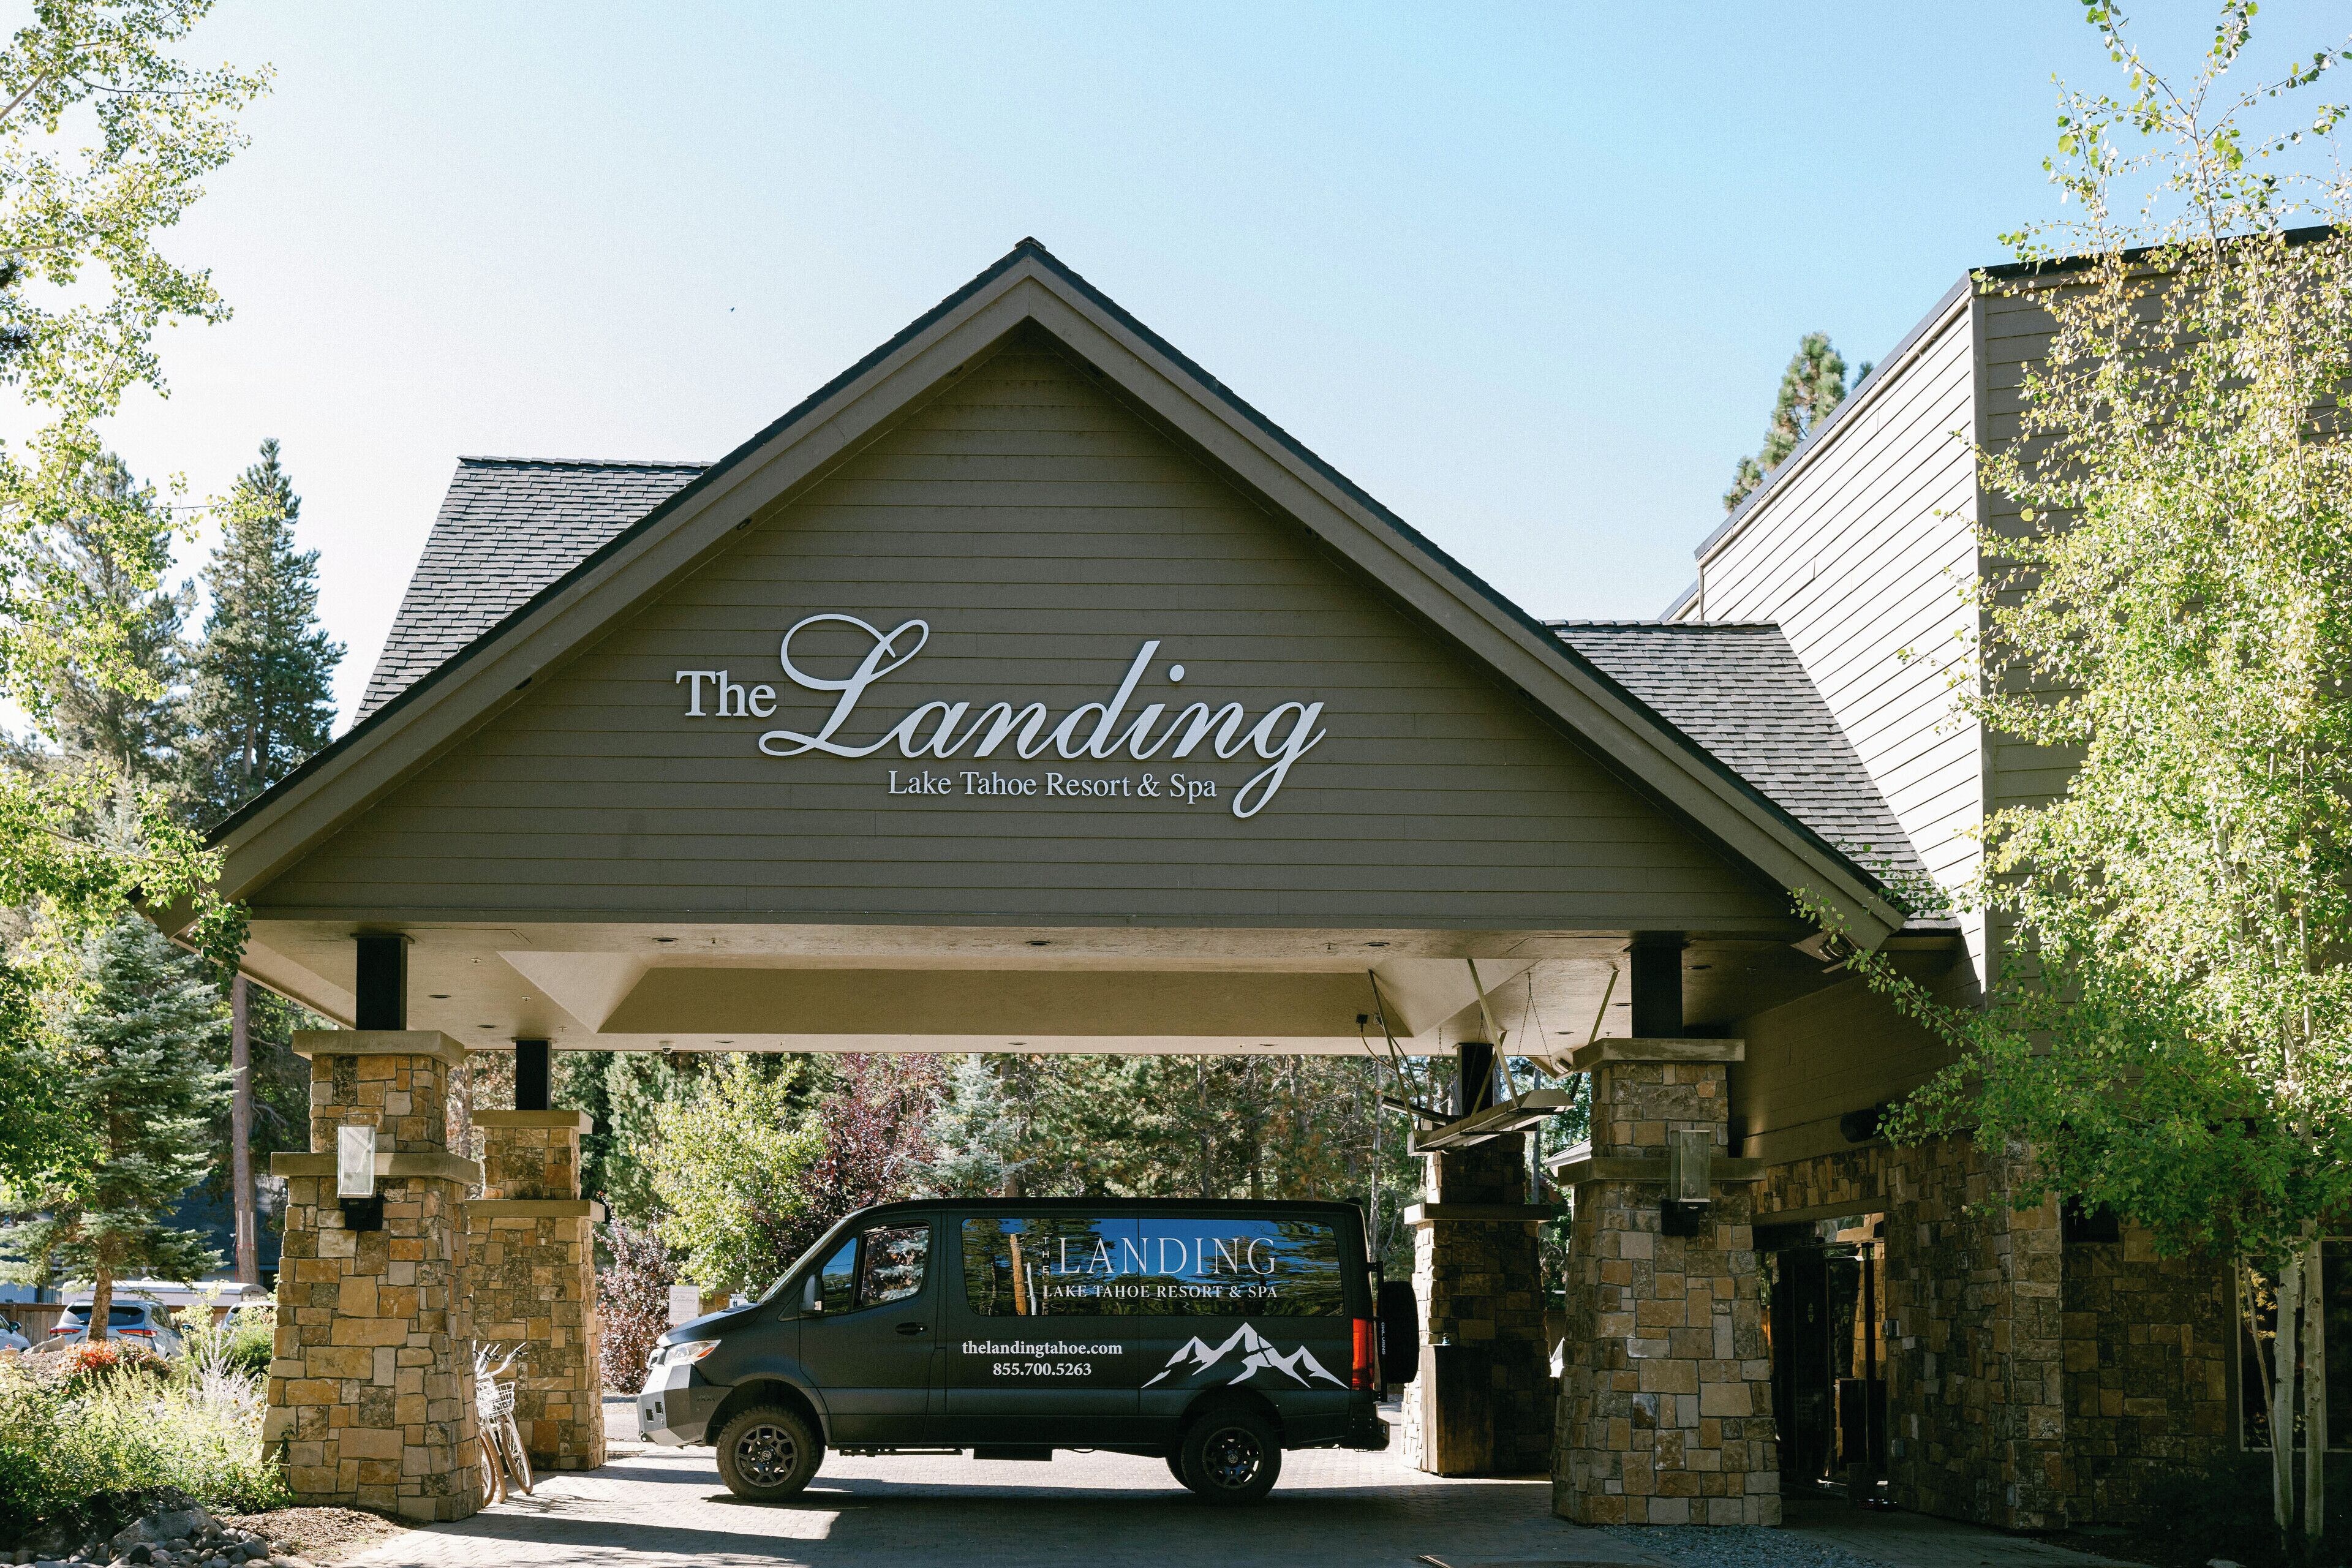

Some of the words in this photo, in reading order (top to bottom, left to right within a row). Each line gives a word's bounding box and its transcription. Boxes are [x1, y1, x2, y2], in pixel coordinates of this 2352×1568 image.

[676, 670, 777, 717] The
[758, 613, 1327, 818] Landing
[888, 771, 952, 796] Lake
[960, 771, 1037, 796] Tahoe
[1046, 772, 1131, 797] Resort
[1137, 774, 1159, 797] &
[1170, 774, 1218, 805] Spa
[1059, 1237, 1276, 1275] LANDING
[1044, 1285, 1087, 1297] LAKE
[1093, 1285, 1150, 1298] TAHOE
[1157, 1286, 1223, 1297] RESORT
[1229, 1286, 1242, 1298] &
[1248, 1286, 1278, 1298] SPA
[962, 1341, 1123, 1358] thelandingtahoe.com
[993, 1363, 1091, 1376] 855.700.5263
